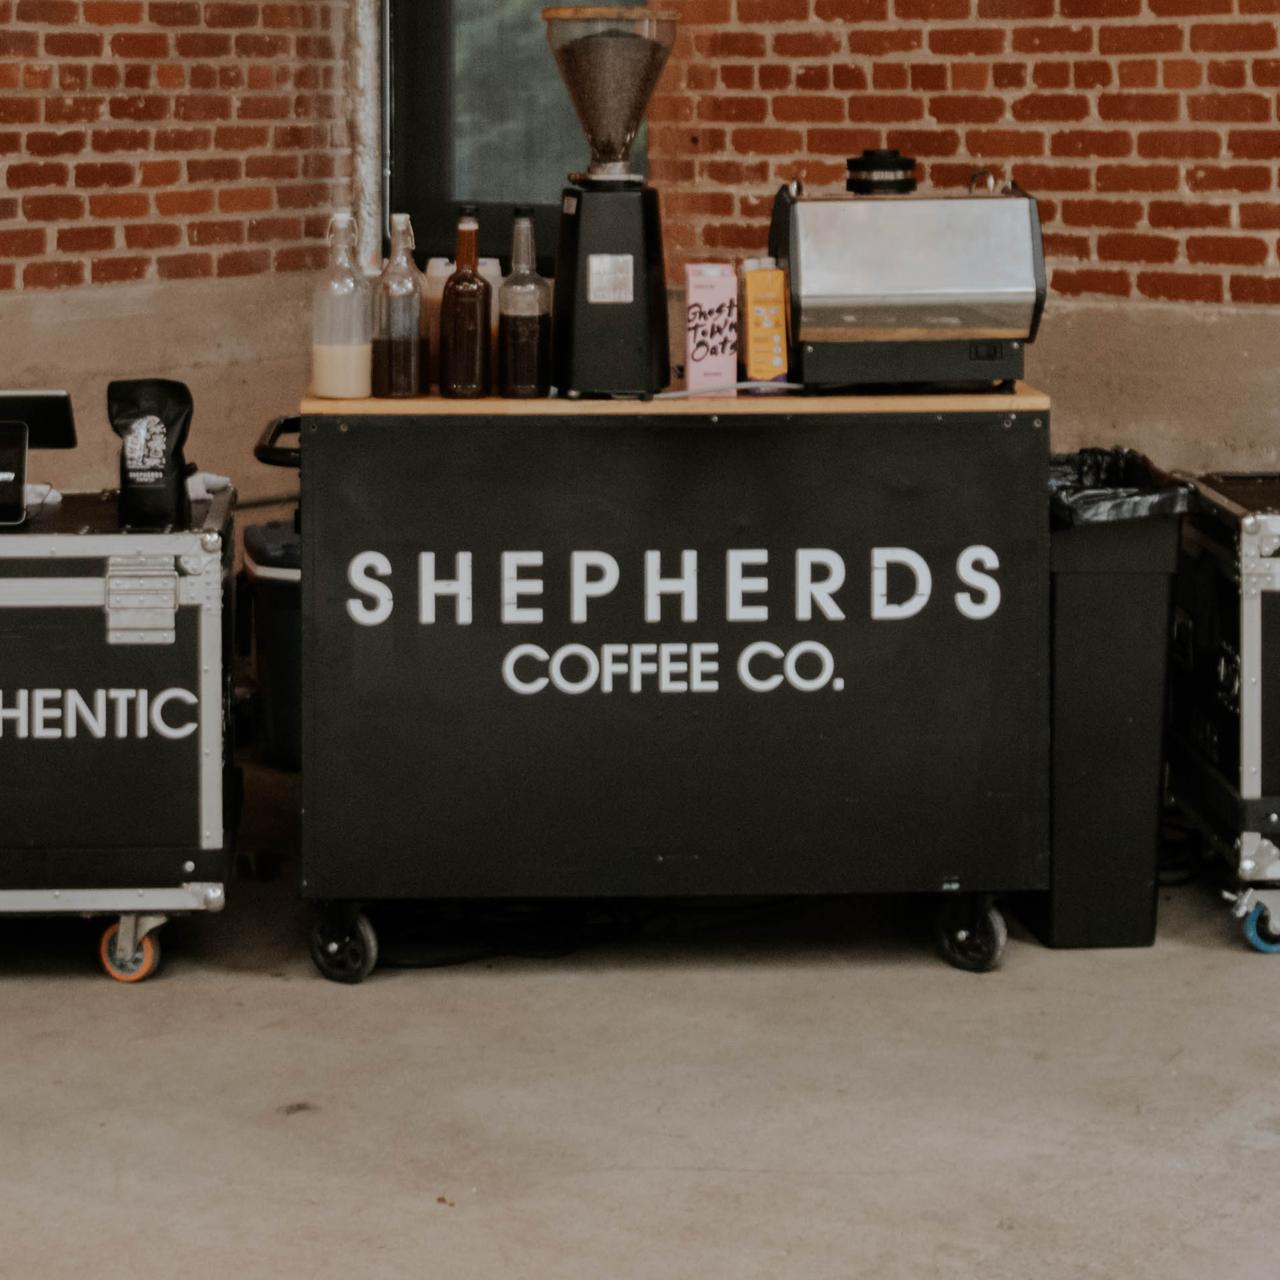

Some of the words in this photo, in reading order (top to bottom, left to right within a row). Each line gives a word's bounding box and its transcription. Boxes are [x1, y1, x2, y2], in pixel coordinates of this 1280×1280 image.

[688, 298, 738, 323] Ghost
[688, 320, 737, 343] Town
[691, 337, 738, 362] Oats
[346, 544, 1002, 627] SHEPHERDS
[501, 642, 719, 695] COFFEE
[737, 640, 845, 693] CO.
